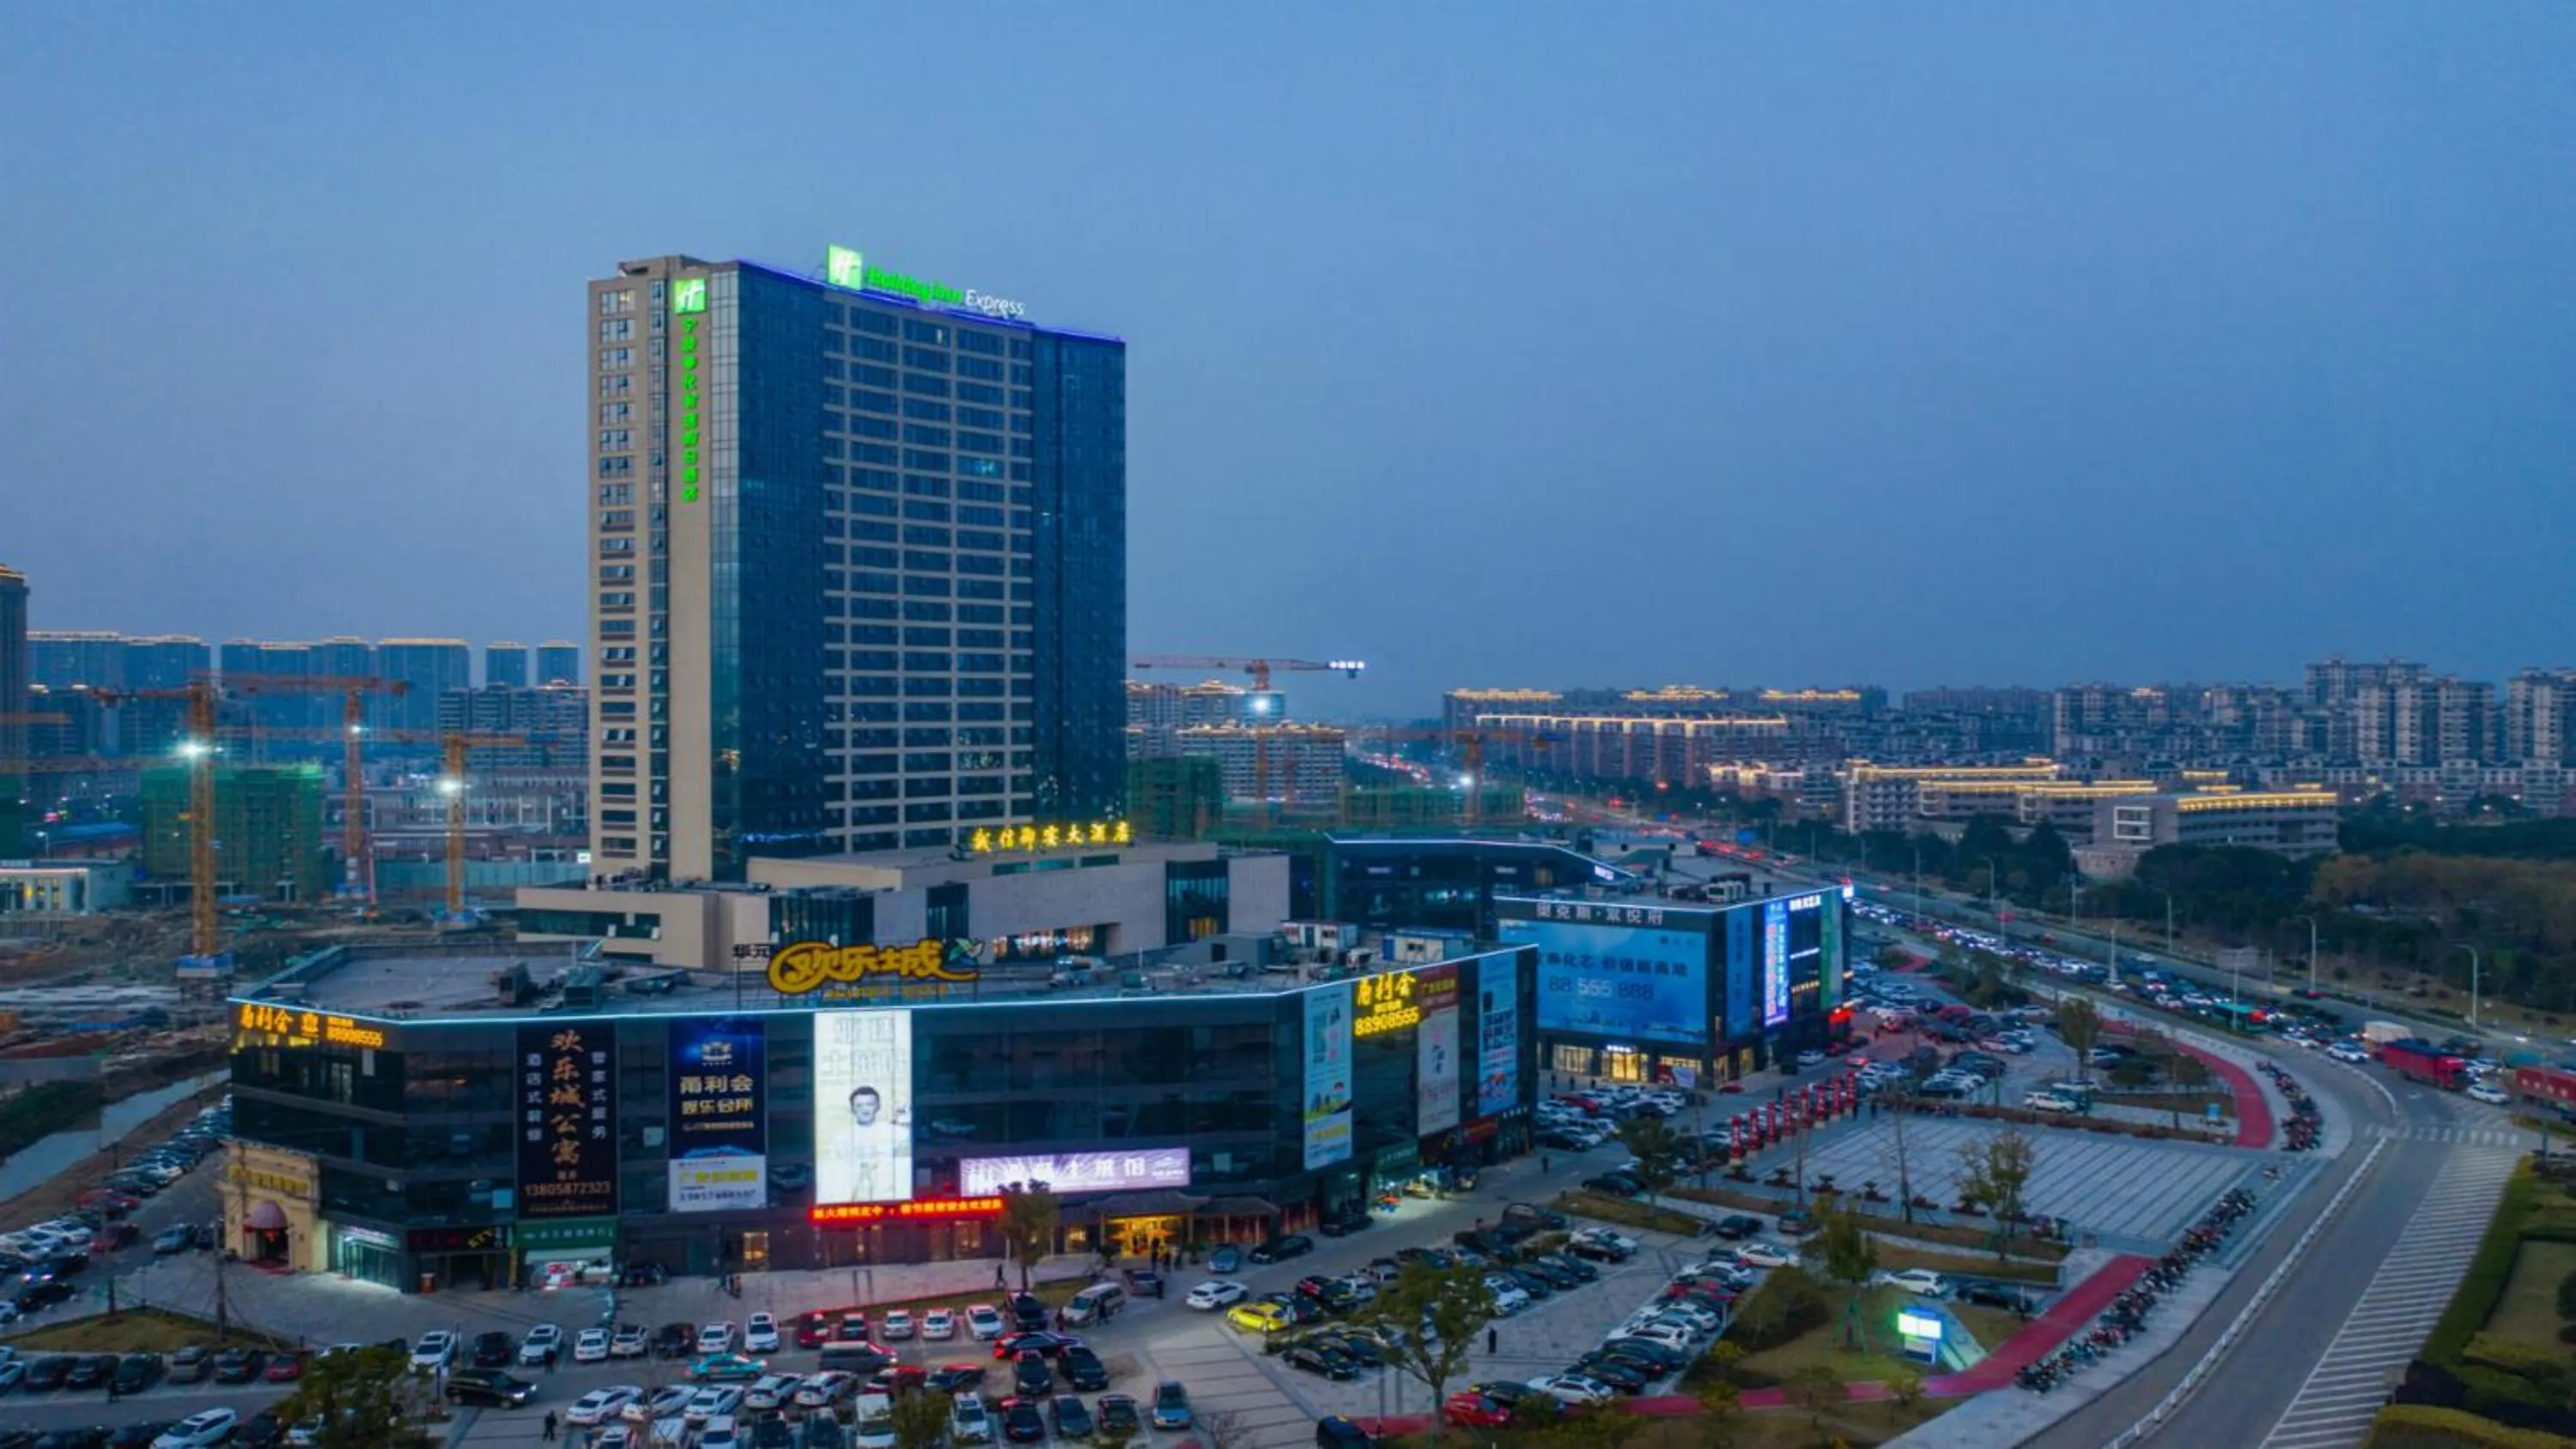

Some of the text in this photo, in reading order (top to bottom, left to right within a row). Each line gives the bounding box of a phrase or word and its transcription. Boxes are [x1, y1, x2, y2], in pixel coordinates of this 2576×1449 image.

[965, 289, 1025, 318] Express
[768, 938, 980, 994] 欢乐城
[1577, 977, 1612, 997] 555
[550, 1030, 586, 1164] 欢乐城公寓
